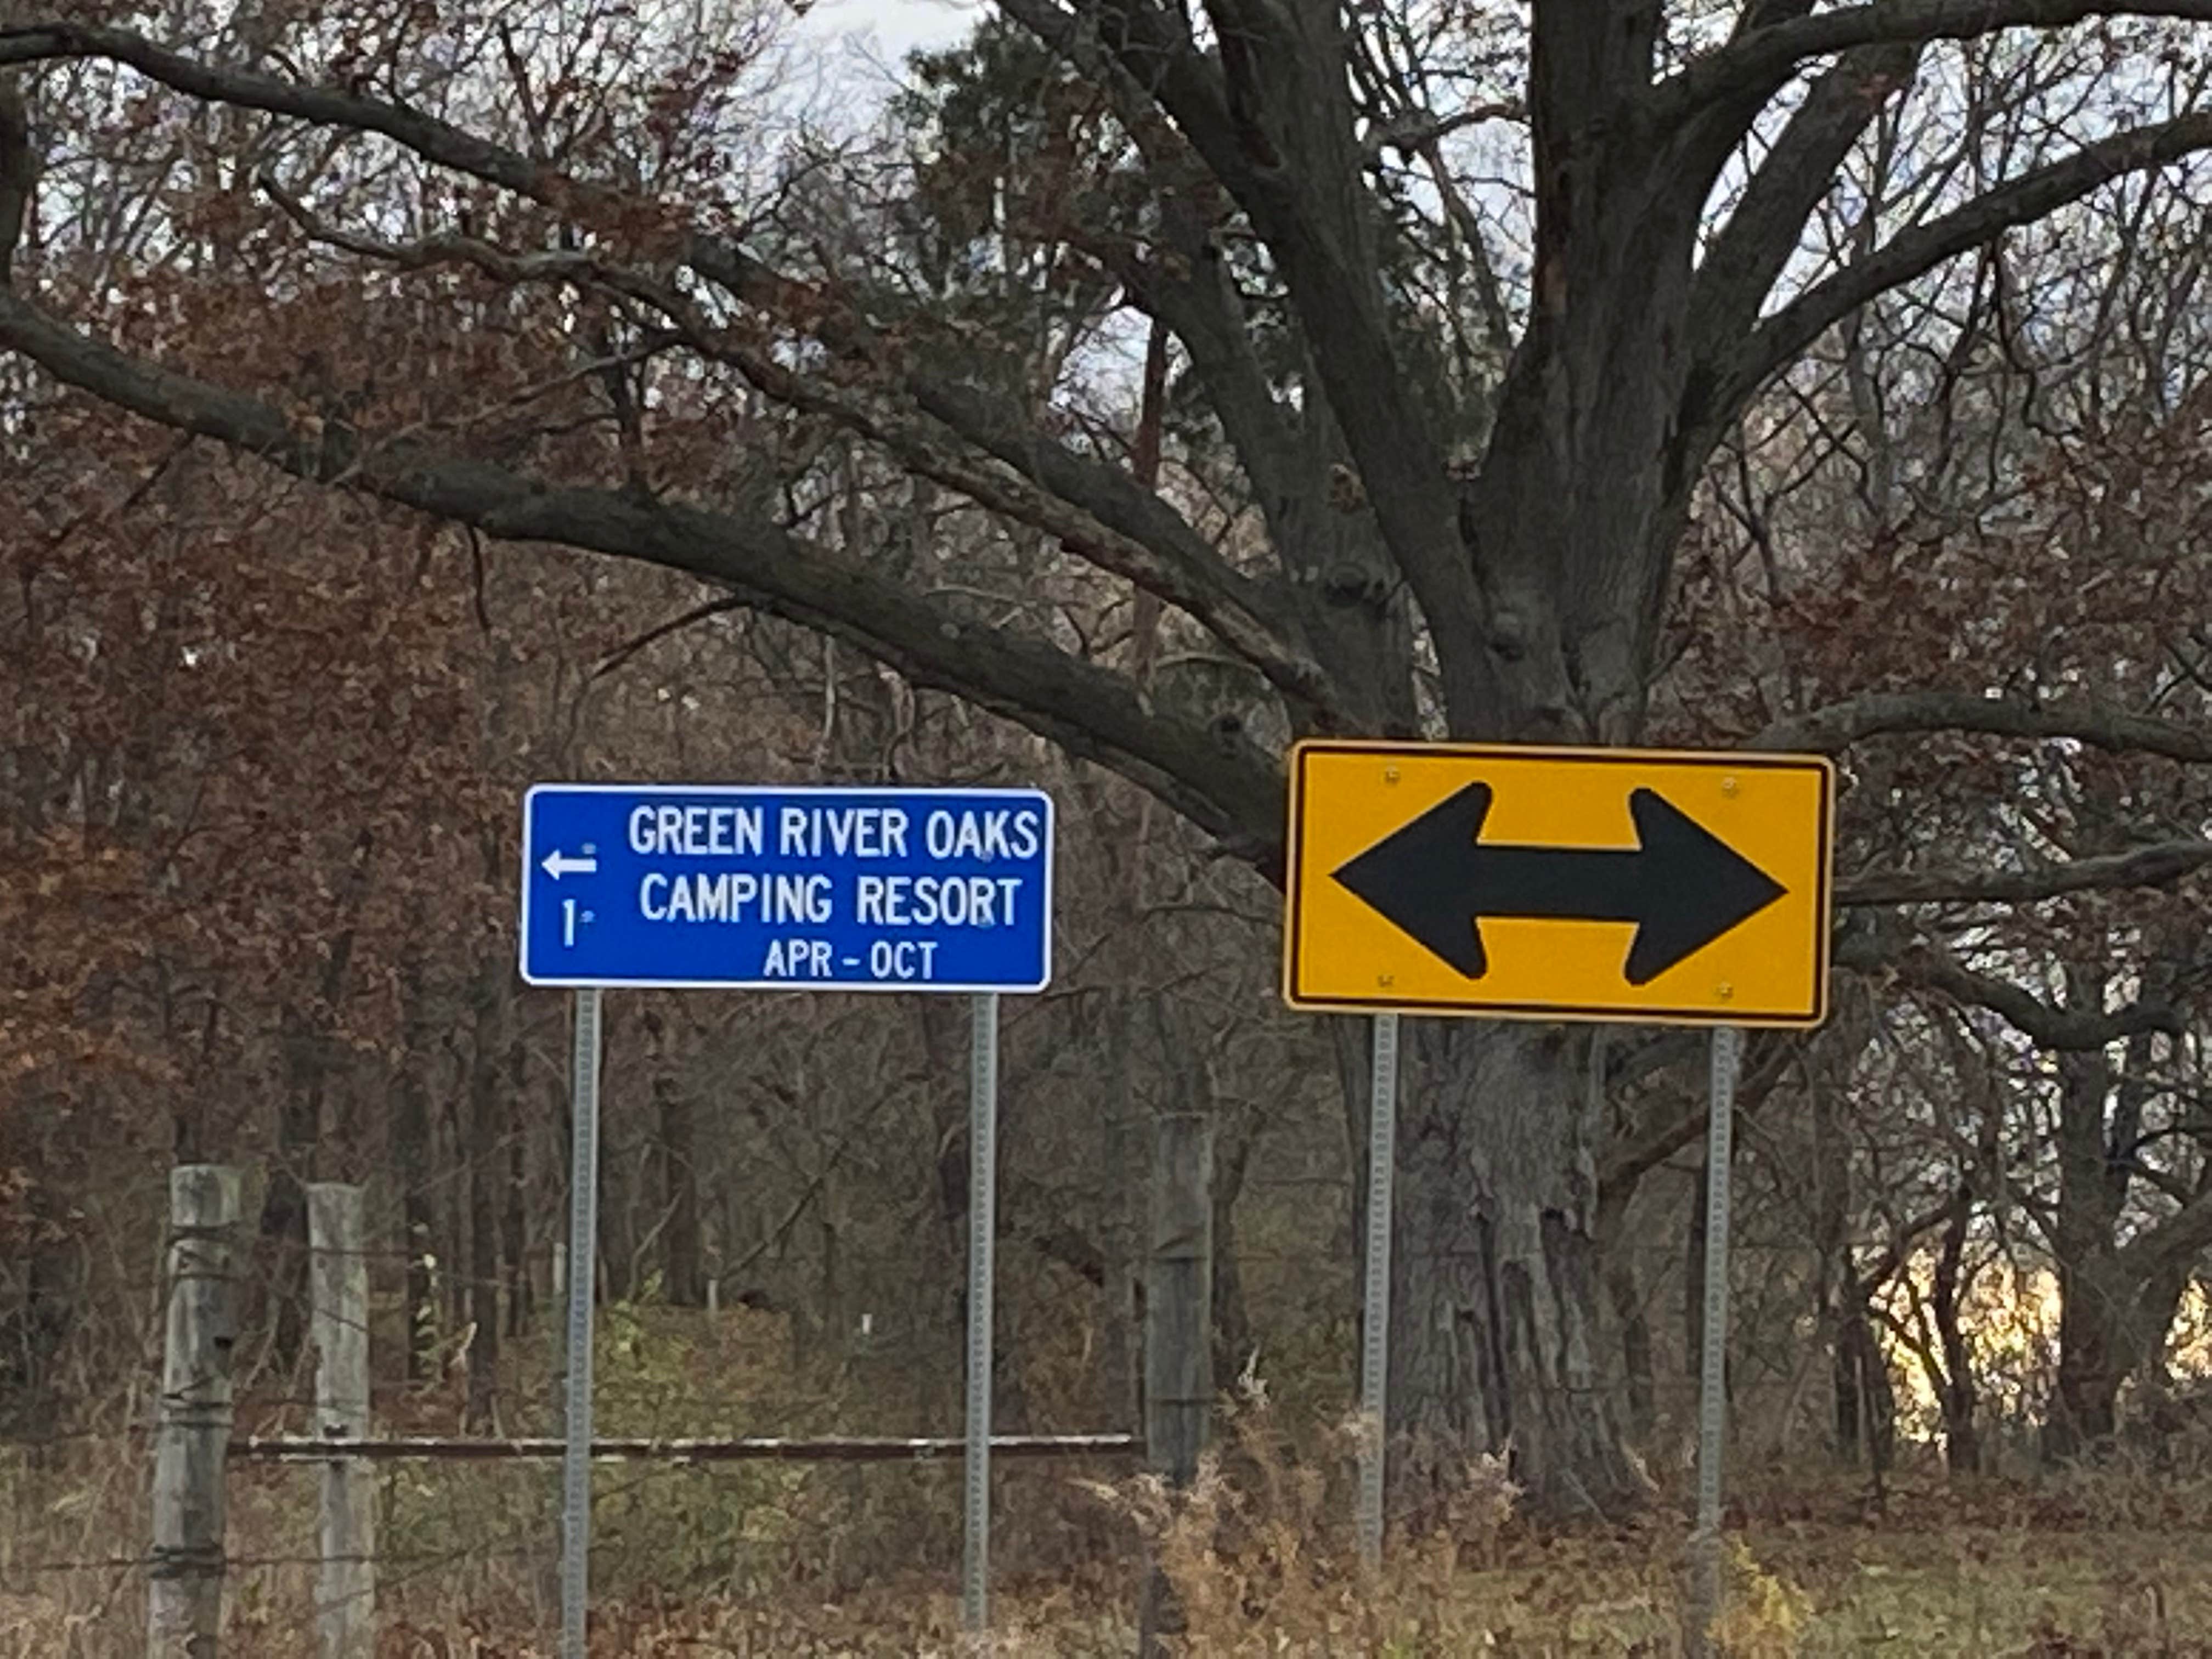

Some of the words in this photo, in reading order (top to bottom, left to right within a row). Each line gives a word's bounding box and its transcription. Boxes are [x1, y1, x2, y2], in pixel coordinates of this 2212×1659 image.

[629, 805, 763, 856] GREEN
[780, 807, 909, 858] RIVER
[926, 809, 1039, 859] OAKS
[562, 899, 575, 947] 1
[640, 873, 833, 924] CAMPING
[856, 876, 1023, 926] RESORT
